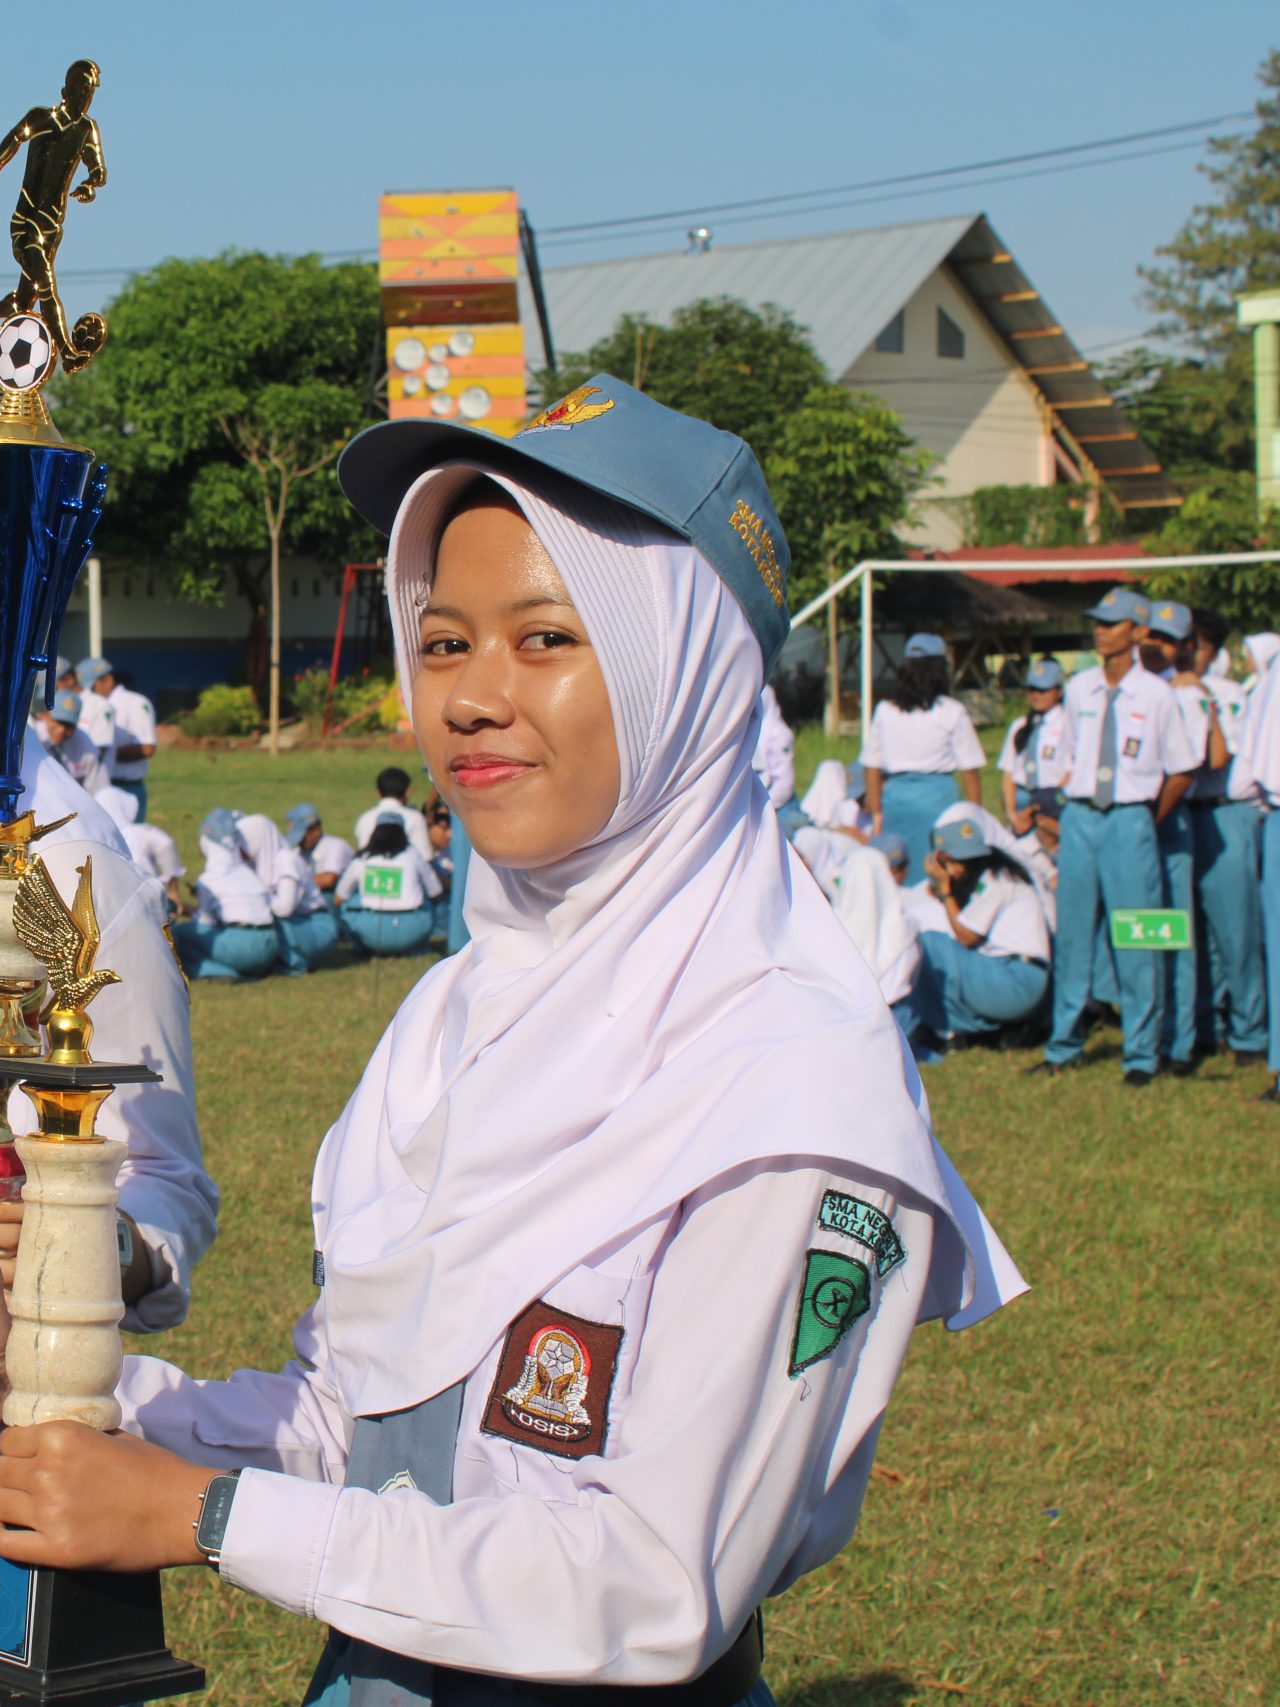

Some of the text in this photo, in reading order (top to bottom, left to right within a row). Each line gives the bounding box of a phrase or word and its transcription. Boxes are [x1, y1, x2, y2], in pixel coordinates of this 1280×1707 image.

[828, 1196, 858, 1219] SMA
[830, 1212, 865, 1237] KOTA
[519, 1412, 570, 1437] OSIS
